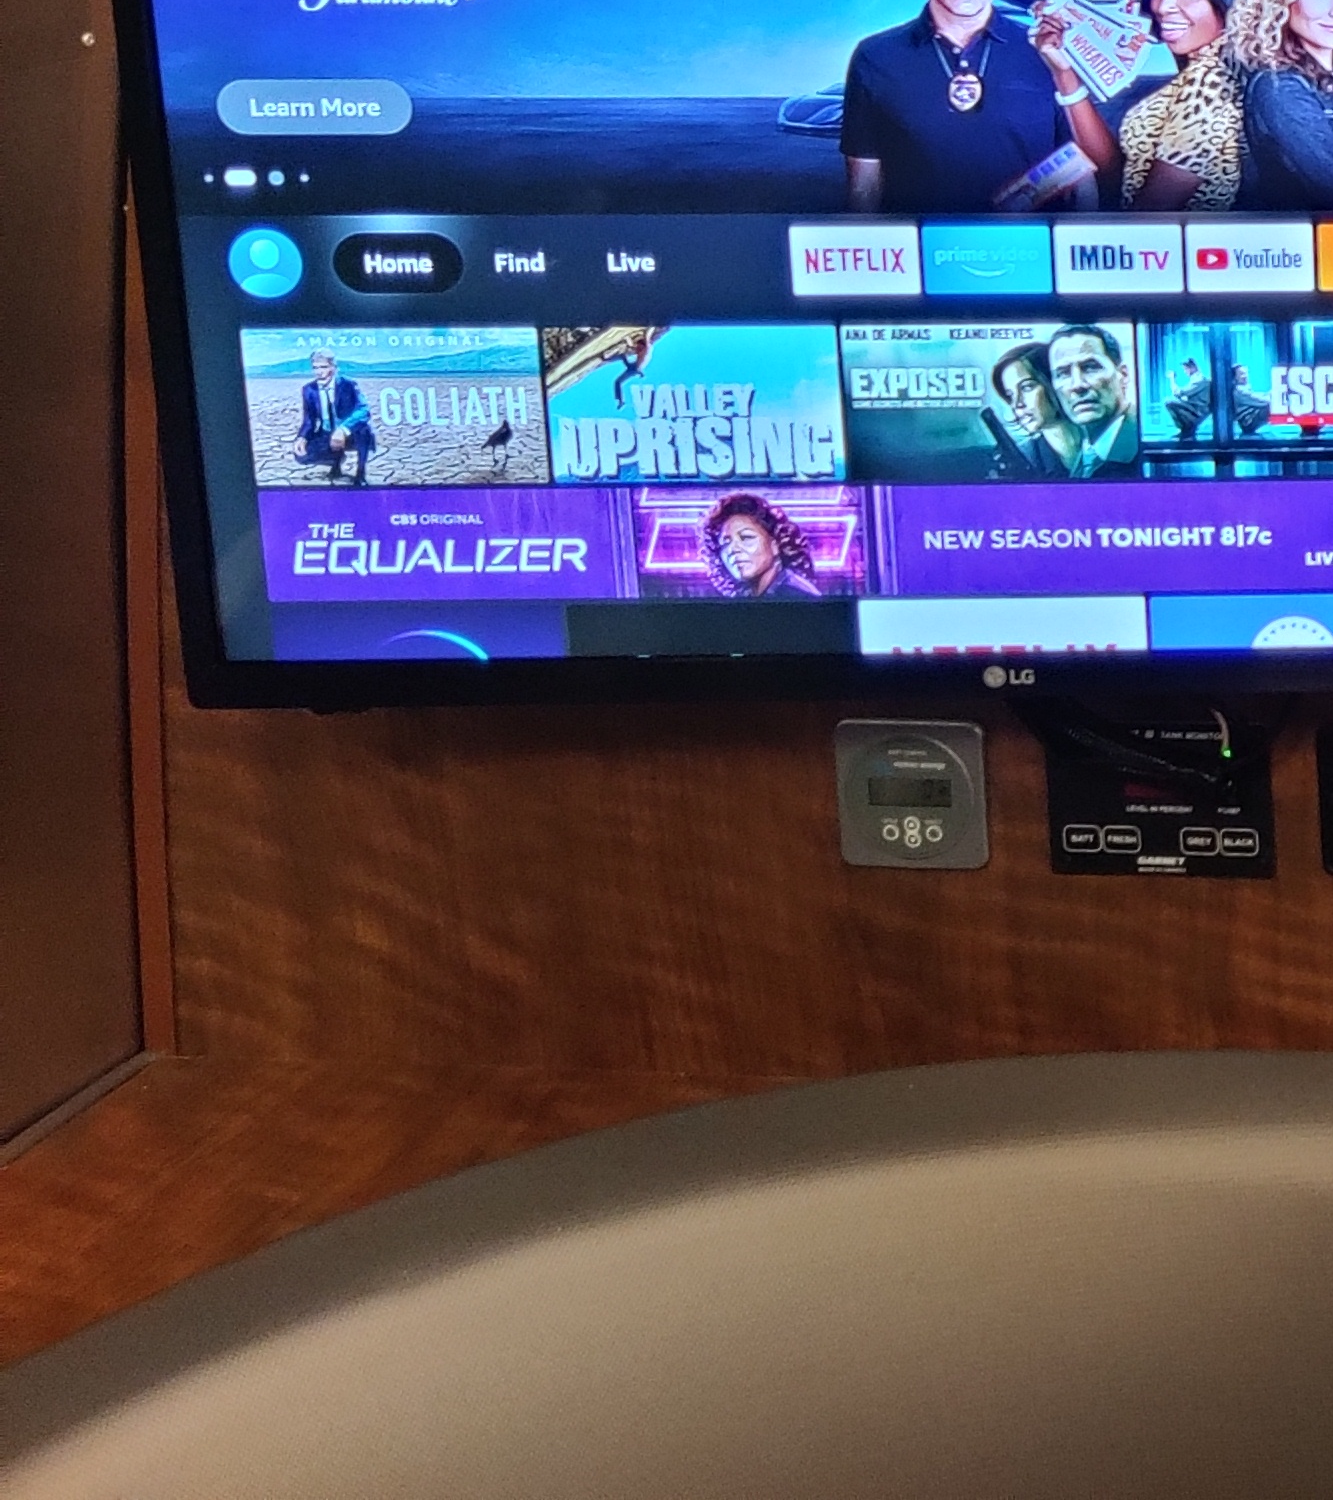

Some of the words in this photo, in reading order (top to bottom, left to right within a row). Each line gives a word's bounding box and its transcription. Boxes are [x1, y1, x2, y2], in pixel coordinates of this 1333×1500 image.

[1069, 33, 1125, 88] WHEATIES
[249, 98, 315, 118] Learn
[321, 98, 382, 118] More
[363, 252, 434, 275] Home
[495, 252, 545, 273] Find
[607, 252, 656, 272] Live
[804, 247, 907, 274] NETFLIX
[934, 247, 988, 266] prime
[990, 247, 1040, 263] video
[1069, 245, 1133, 271] IMDb
[1138, 250, 1169, 270] TV
[1233, 248, 1302, 268] YouTube
[296, 336, 376, 347] AMAZON
[388, 336, 484, 347] ORIGINAL
[845, 328, 868, 341] ANA
[872, 328, 886, 341] DE
[890, 328, 931, 341] ARMAS
[949, 328, 989, 340] KEANU
[990, 328, 1034, 340] REEVES
[851, 367, 986, 400] EXPOSED
[379, 386, 529, 426] GOLIATH
[630, 383, 755, 418] VALLEY
[555, 415, 837, 479] UPRISING
[390, 514, 417, 525] CBS
[420, 514, 484, 525] ORIGINAL
[308, 523, 355, 538] THE
[924, 530, 984, 549] NEW
[990, 529, 1092, 549] SEASON
[1096, 527, 1215, 547] TONIGHT
[294, 538, 588, 576] EQUALIZER
[1009, 668, 1035, 685] LG
[1185, 732, 1223, 741] MONITO
[1223, 837, 1254, 847] BLACK
